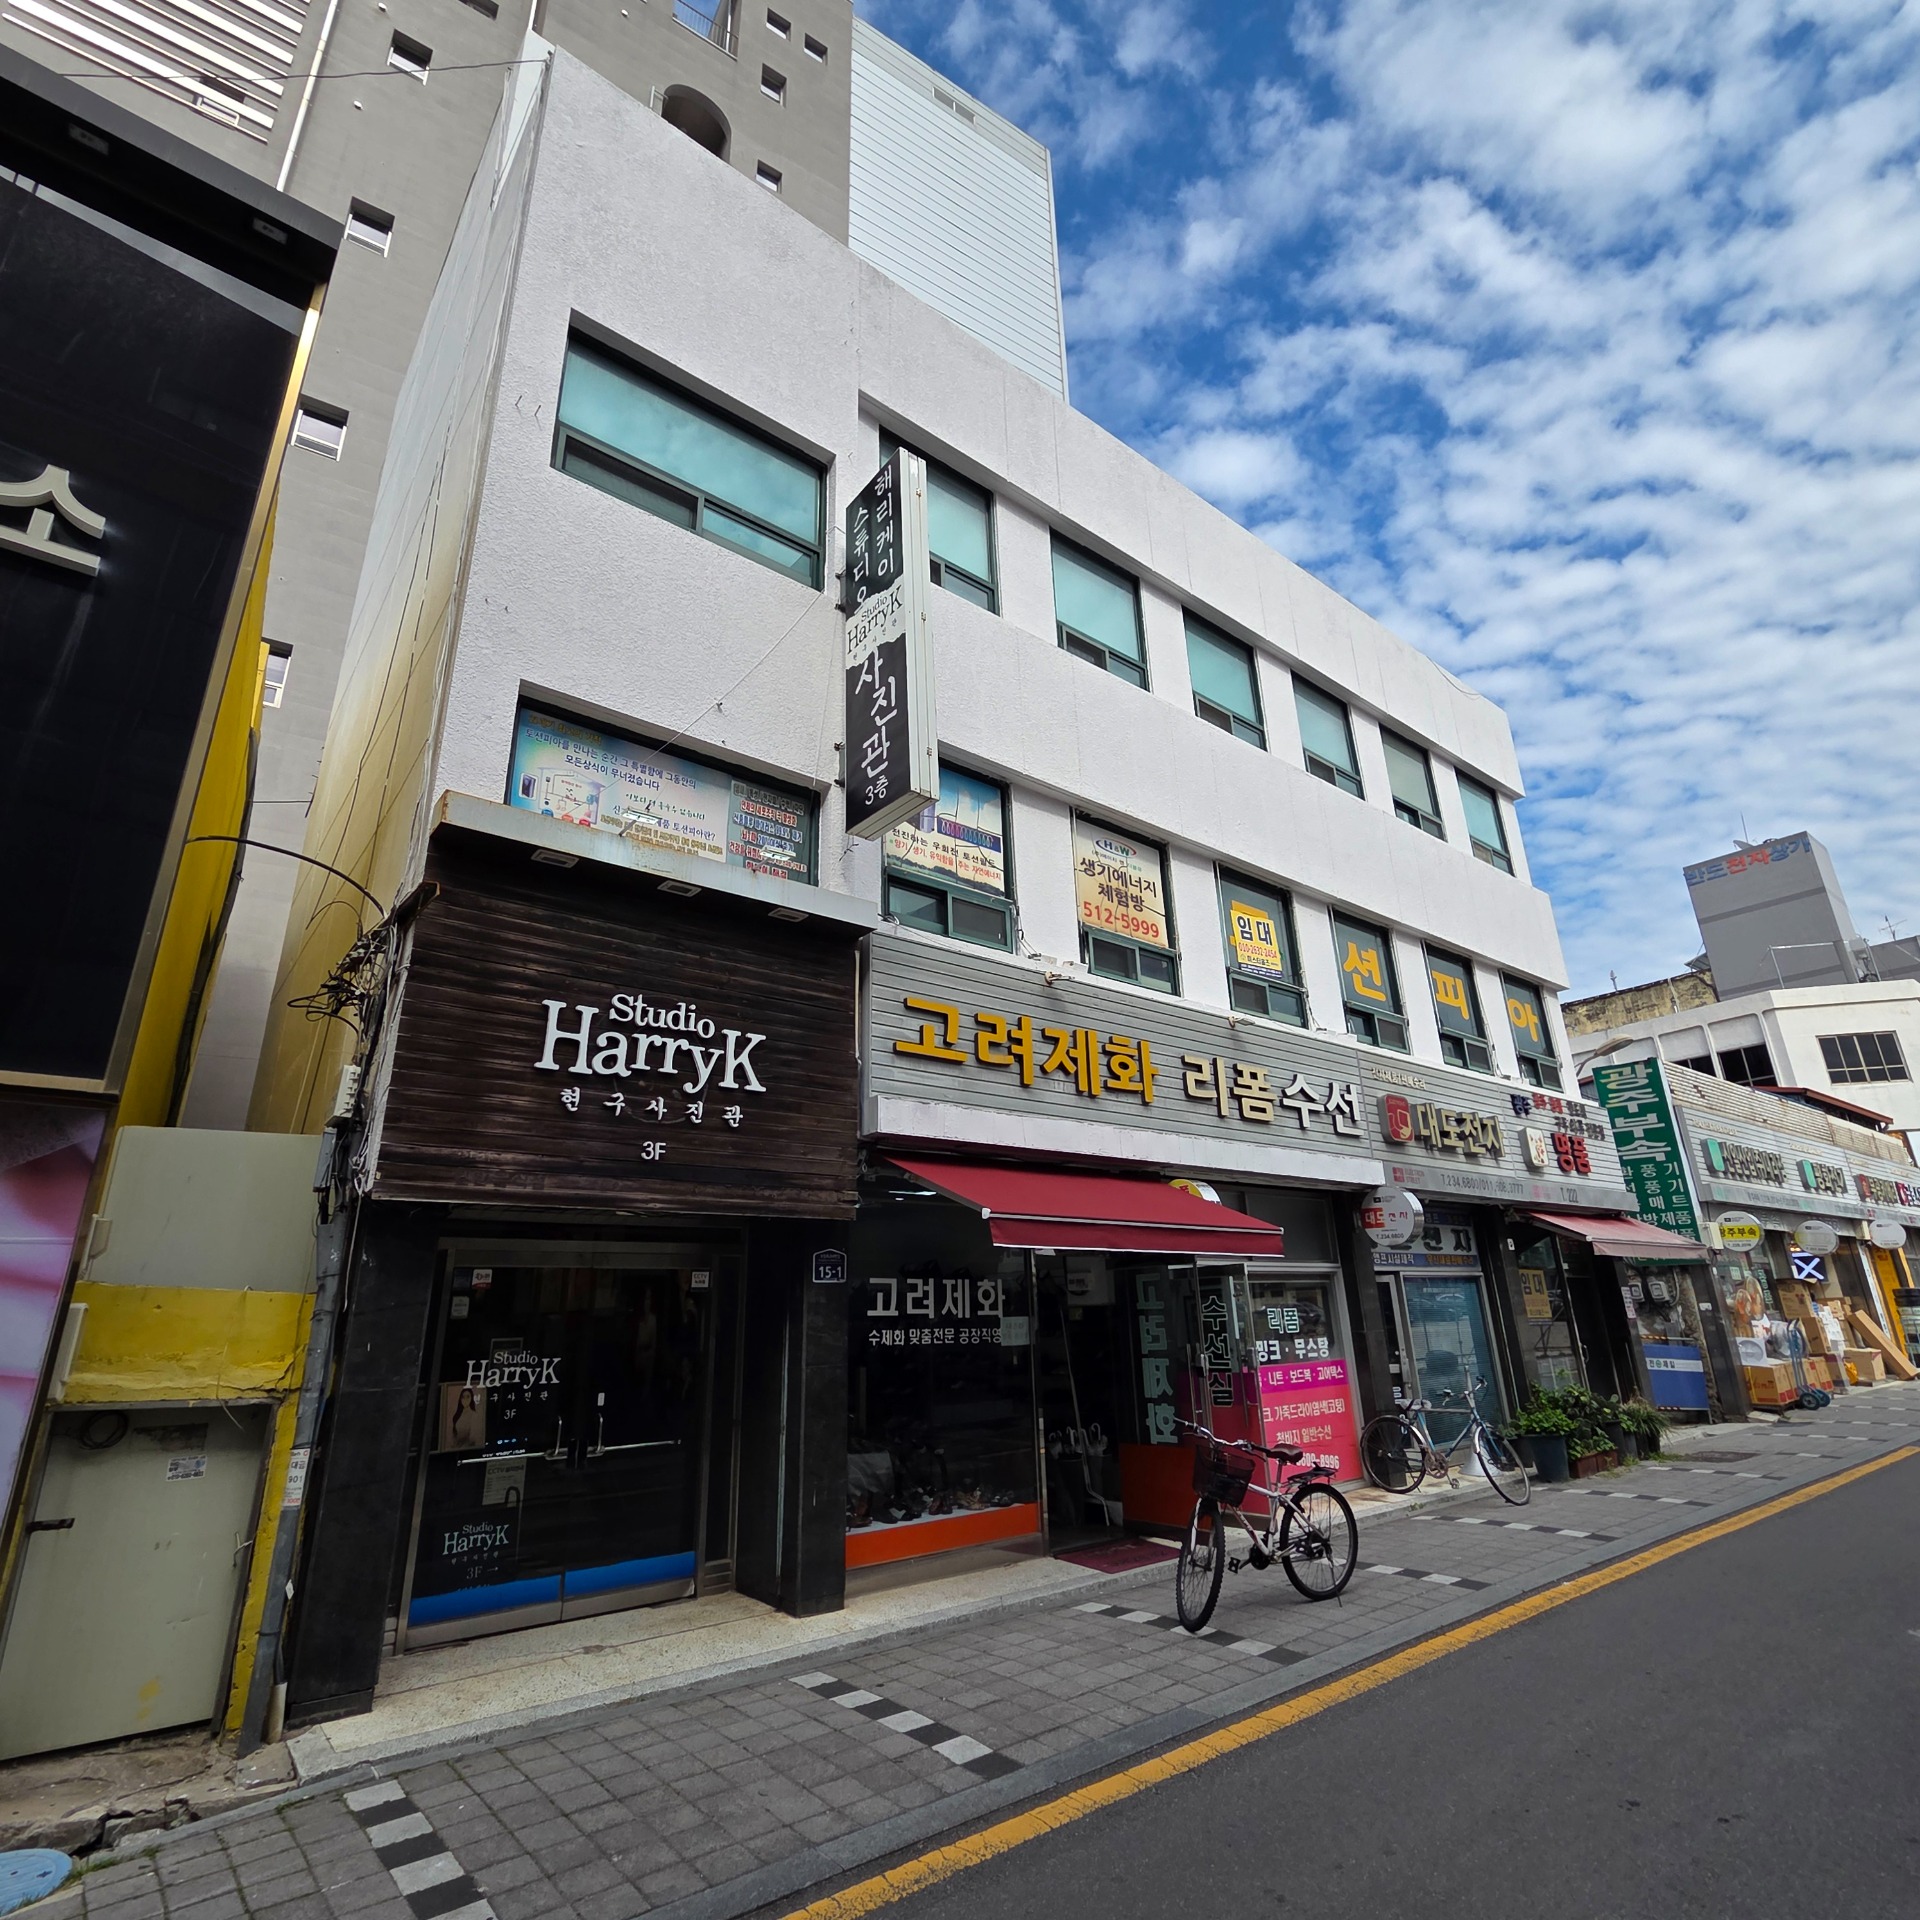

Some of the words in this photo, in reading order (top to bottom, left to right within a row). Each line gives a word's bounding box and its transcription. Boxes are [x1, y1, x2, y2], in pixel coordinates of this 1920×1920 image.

[846, 585, 904, 656] HarryK
[860, 594, 888, 624] Studio
[855, 650, 898, 780] 사진관
[573, 742, 599, 760] 만나는
[601, 752, 619, 764] 순간
[620, 758, 629, 768] 그
[665, 771, 697, 790] 그동안의
[611, 768, 660, 792] 무너졌습니다
[865, 775, 889, 806] 3층
[892, 828, 929, 847] 전진하는
[930, 851, 954, 867] 유익함을
[958, 861, 970, 872] 주는
[1080, 857, 1157, 898] 생기에너지
[1098, 883, 1145, 913] 체험방
[1083, 901, 1160, 939] 512-5999
[1237, 915, 1273, 947] 임대
[609, 993, 716, 1039] Studio
[534, 999, 767, 1094] HarryK
[893, 996, 1160, 1105] 고려제화
[1600, 1062, 1672, 1162] 광주부속
[1414, 1102, 1506, 1158] 대도전자
[640, 1141, 667, 1161] 3F
[1552, 1133, 1592, 1174] 명품
[818, 1265, 842, 1279] 15-1
[1521, 1273, 1545, 1296] 임대
[866, 1278, 1006, 1319] 고려제화
[1267, 1308, 1301, 1335] 리폼
[868, 1329, 905, 1346] 수제화
[909, 1328, 955, 1345] 맞춤전문
[1202, 1296, 1234, 1408] 수선실
[1294, 1337, 1330, 1360] 무스탕
[494, 1350, 538, 1365] Studio
[464, 1357, 561, 1390] HarryK
[1269, 1370, 1285, 1386] 니트
[1317, 1366, 1345, 1382] 고어텍스
[504, 1408, 517, 1419] 3F
[1301, 1425, 1332, 1443] 일반수선
[442, 1524, 510, 1556] HarryK
[462, 1522, 494, 1534] Studio
[466, 1566, 484, 1581] 3F
